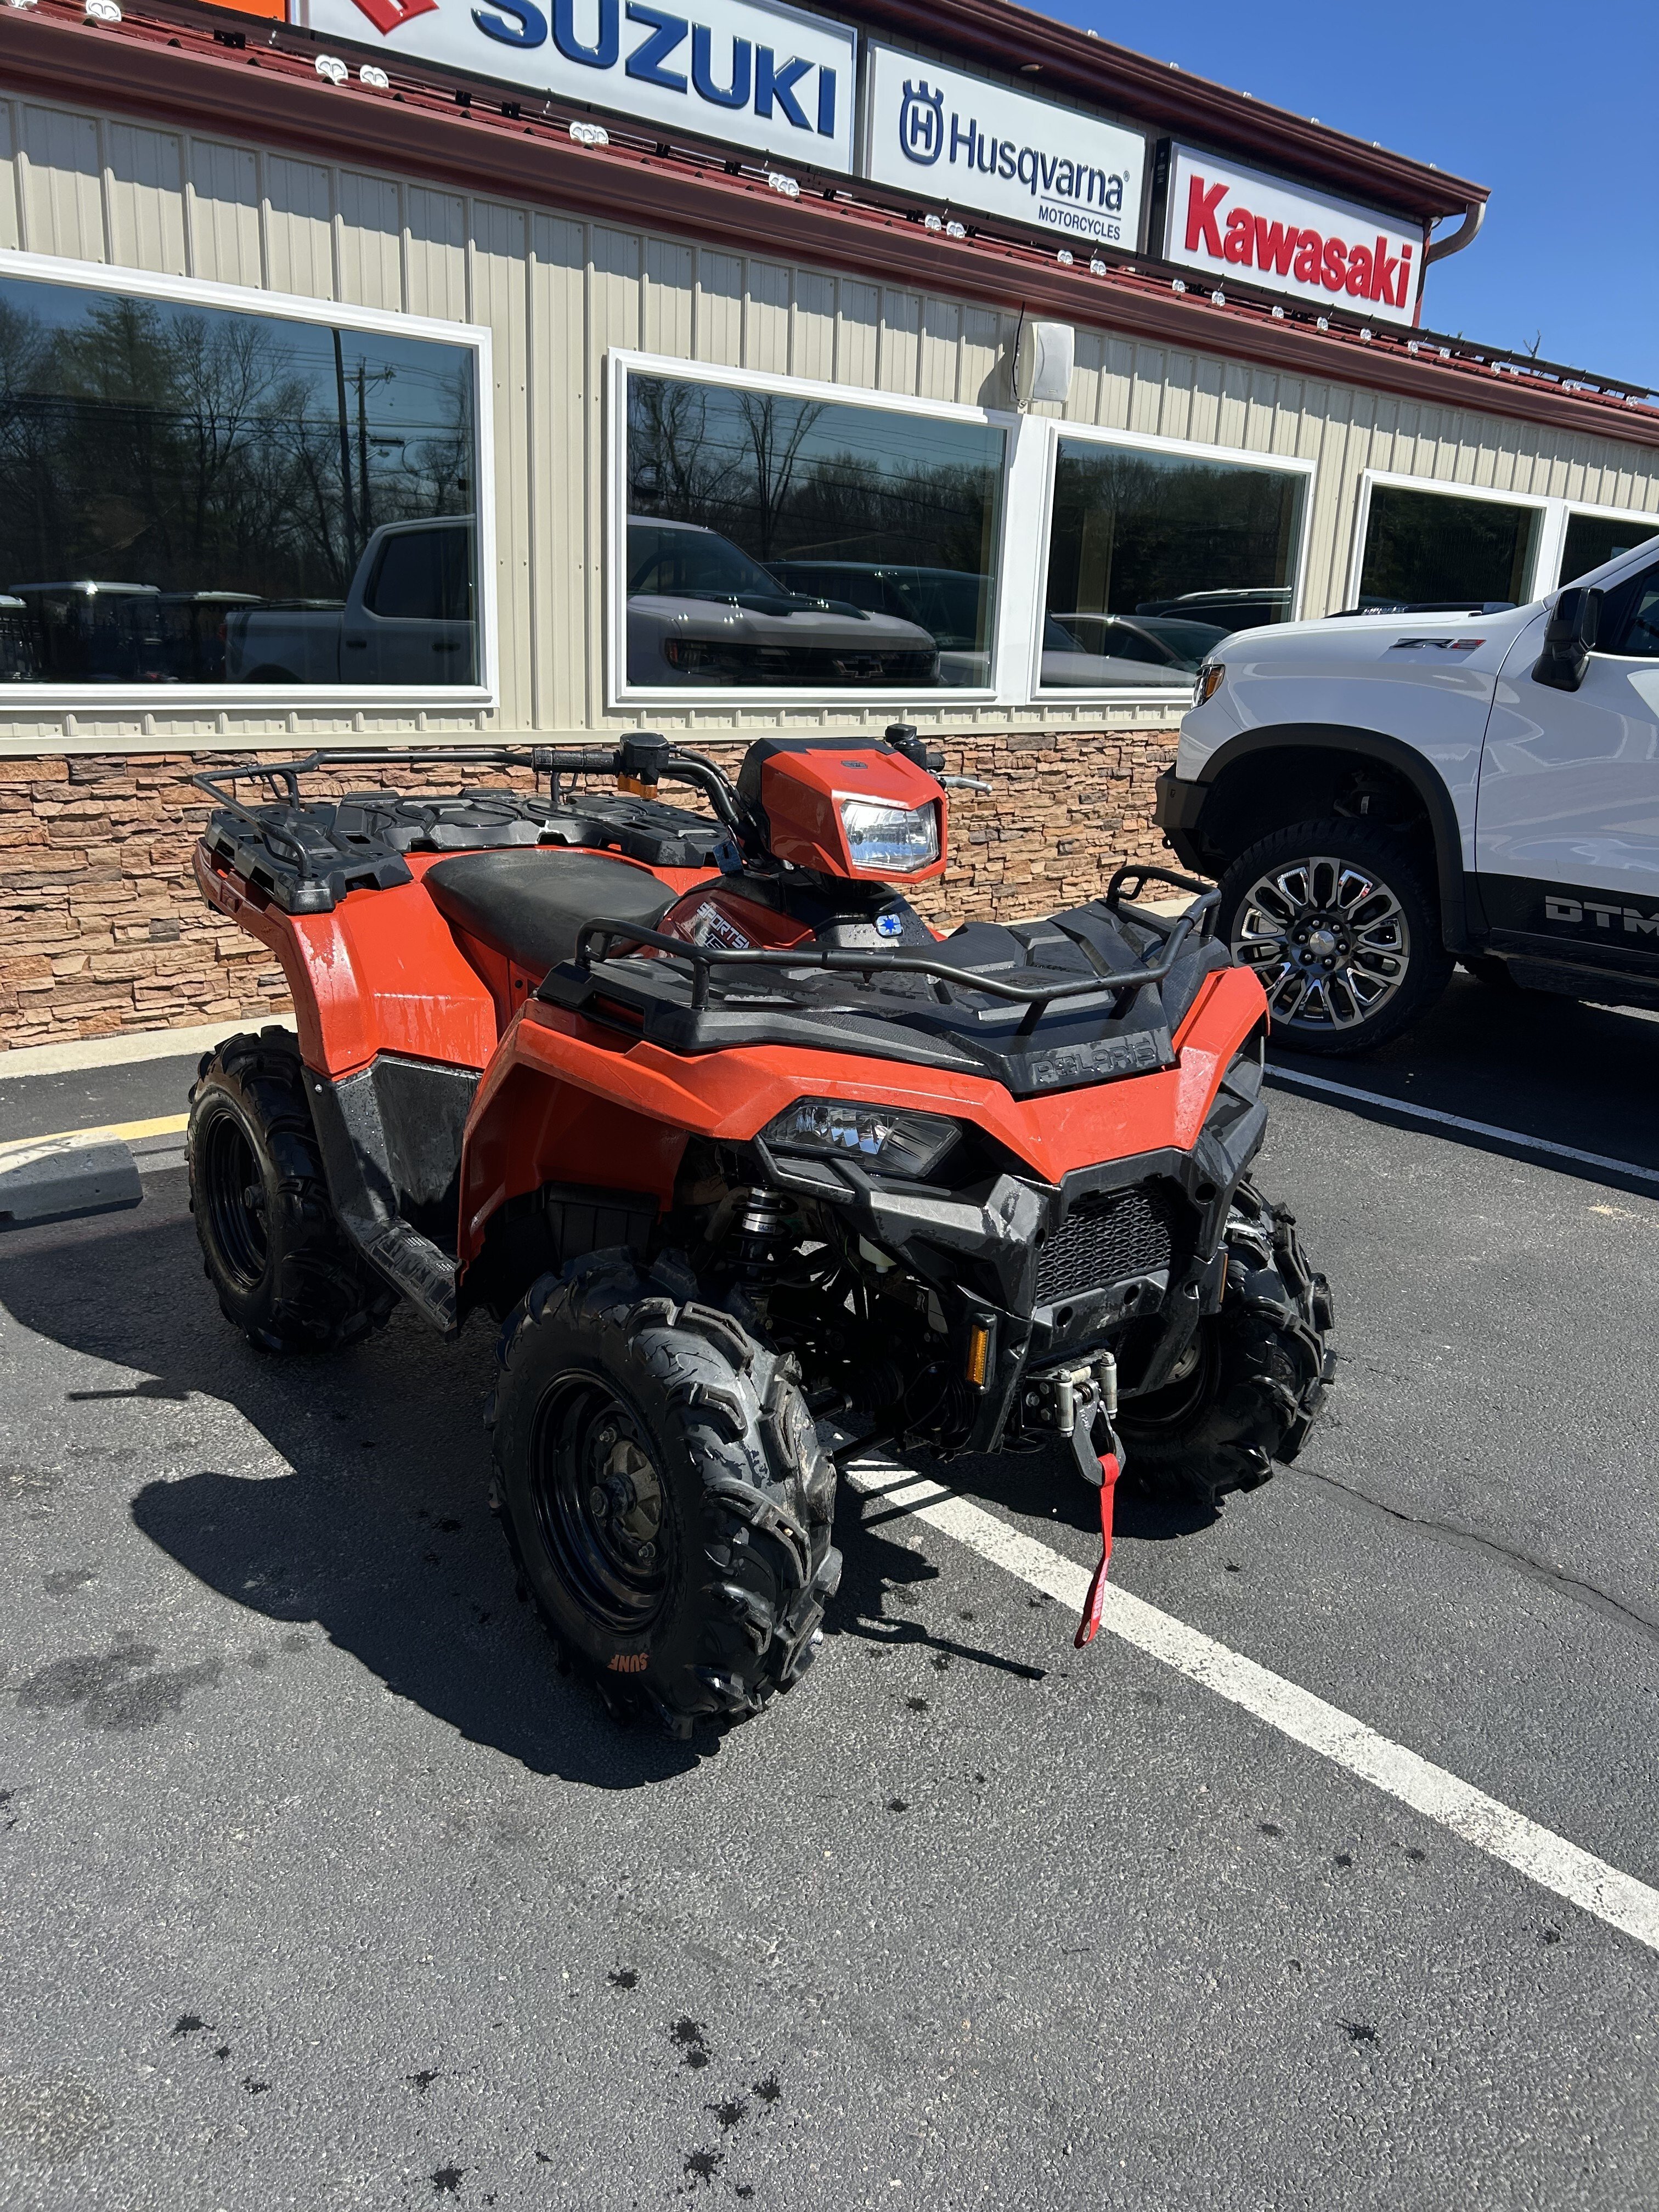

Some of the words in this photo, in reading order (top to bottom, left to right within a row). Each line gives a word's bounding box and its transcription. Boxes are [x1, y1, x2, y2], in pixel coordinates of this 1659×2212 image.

[471, 0, 836, 139] SUZUKI
[949, 112, 1124, 212] Husqvarna
[1038, 205, 1120, 241] MOTORCYCLES
[1185, 173, 1413, 308] Kawasaki
[1032, 1040, 1156, 1084] POLARIS
[607, 1652, 650, 1673] SUNF
